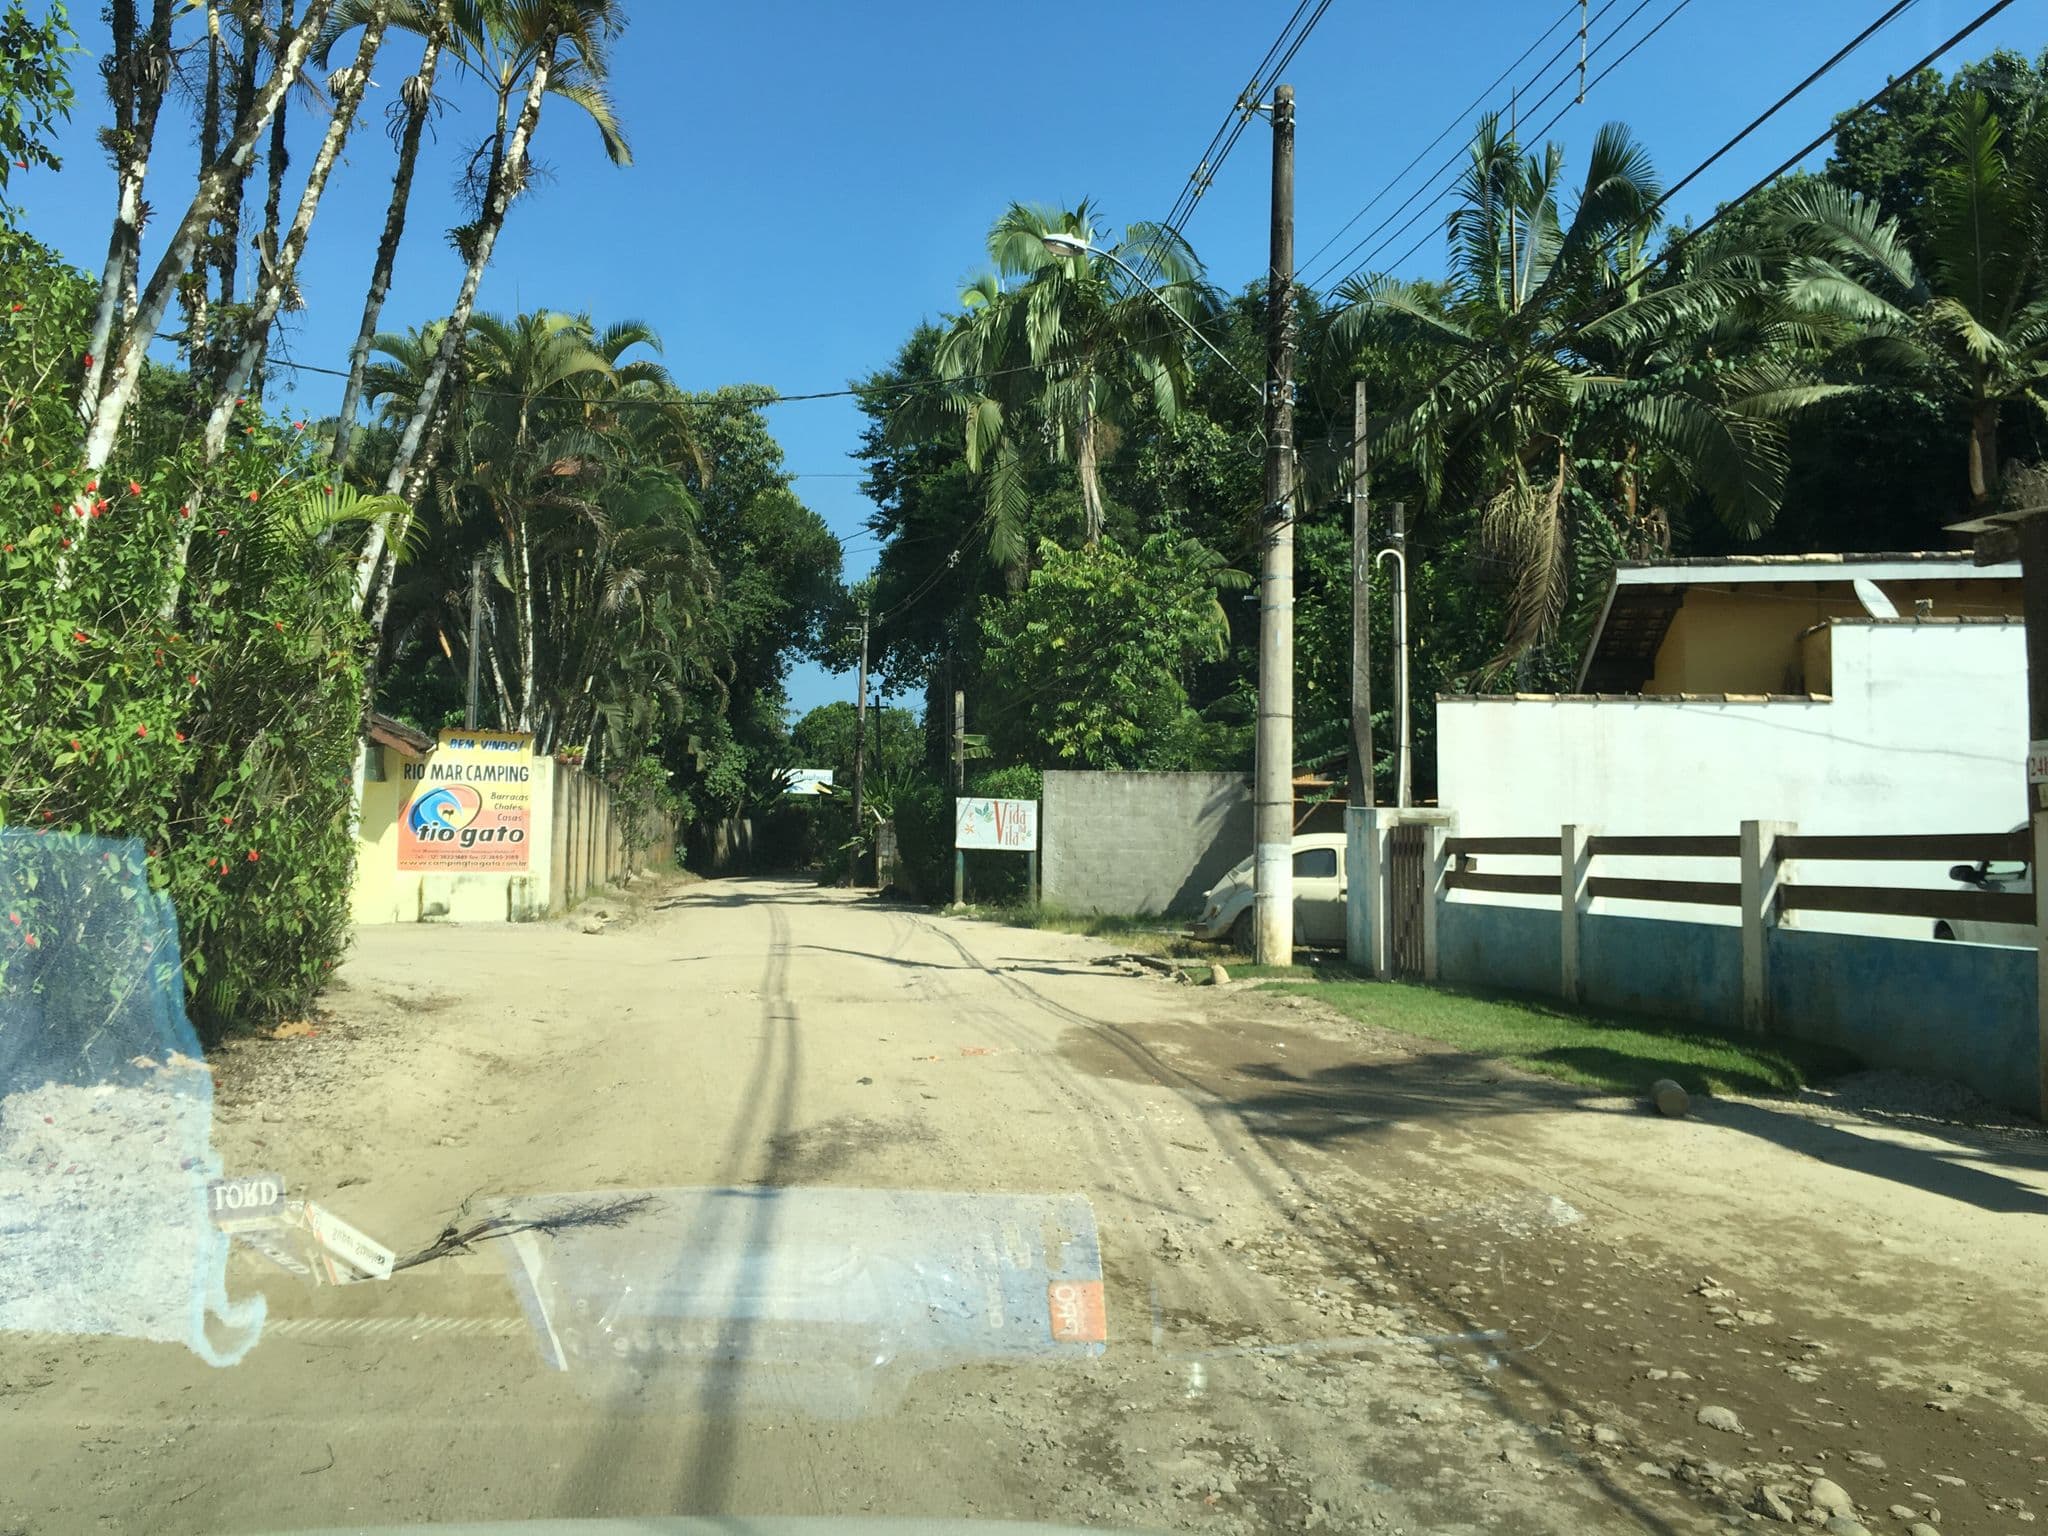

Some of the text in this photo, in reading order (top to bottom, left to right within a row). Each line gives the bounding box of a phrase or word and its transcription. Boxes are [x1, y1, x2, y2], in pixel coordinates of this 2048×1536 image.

[449, 738, 524, 752] BEM VINDO!
[404, 763, 529, 782] RIO MAR CAMPING
[490, 791, 529, 801] Barracas
[497, 813, 523, 822] Casas
[993, 800, 1027, 845] Vida
[417, 822, 525, 848] tio gato
